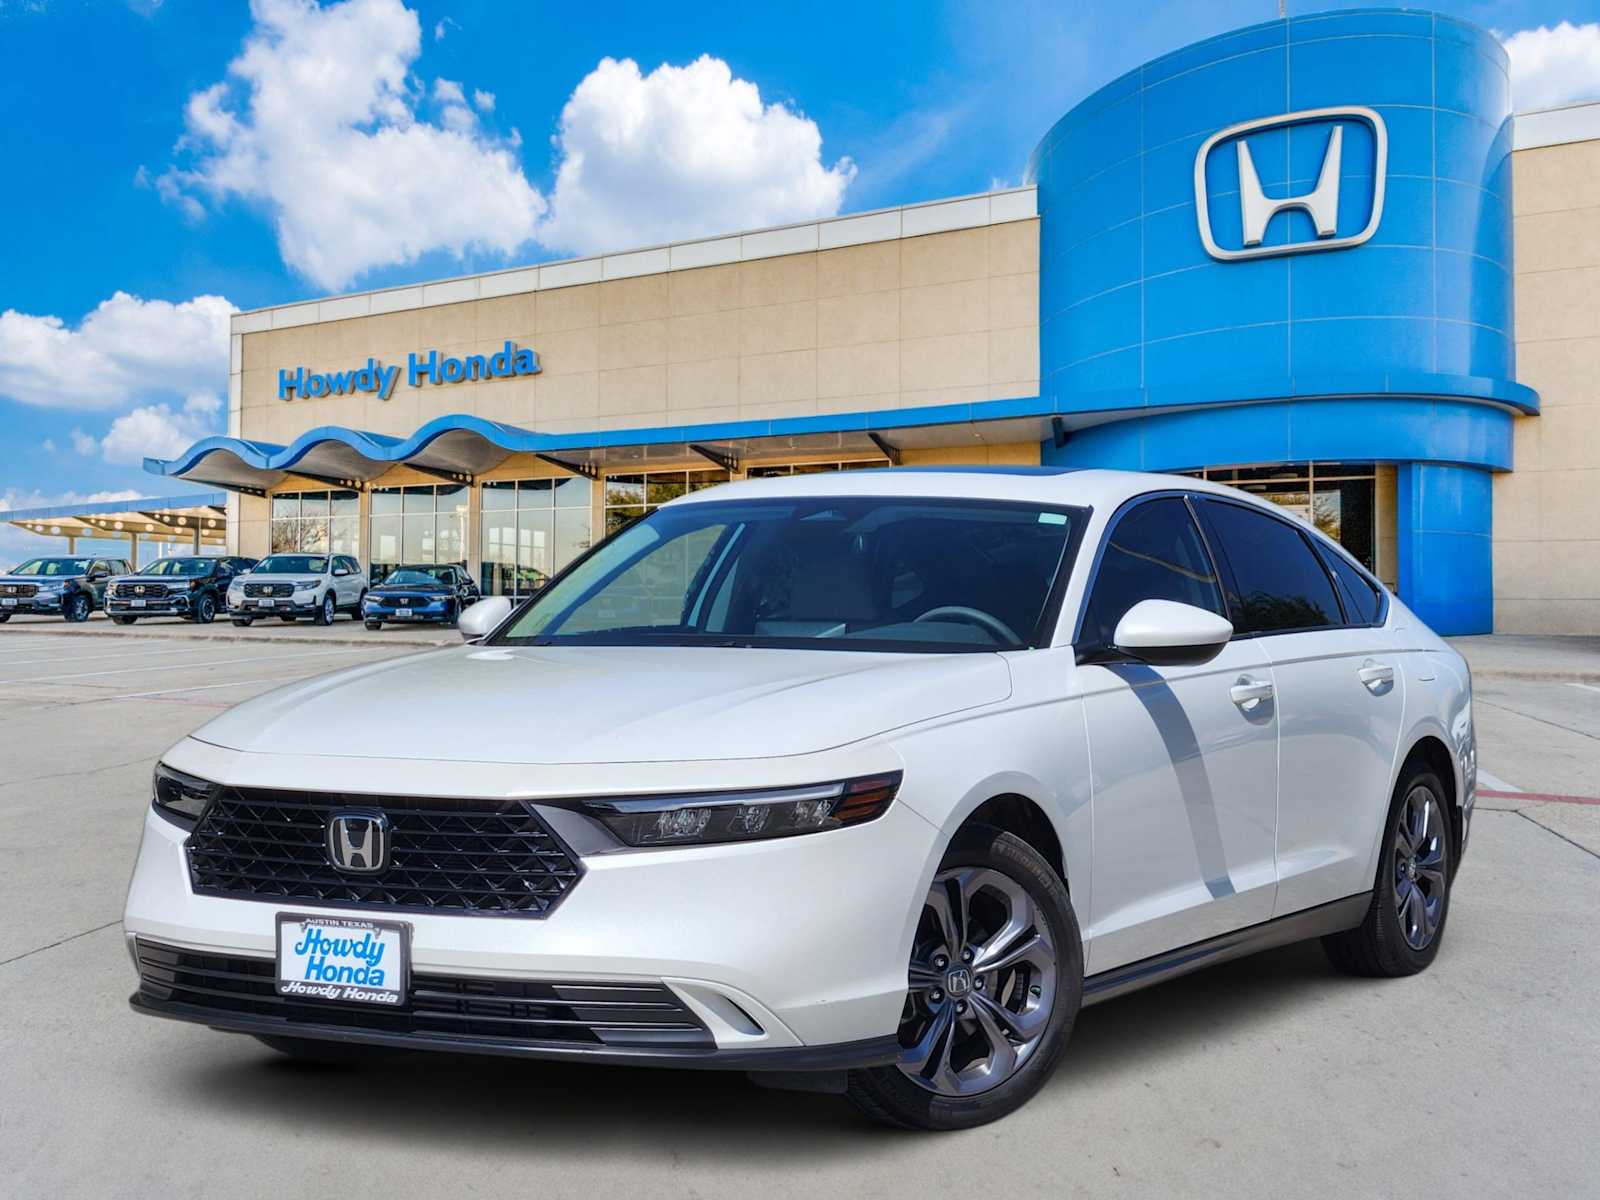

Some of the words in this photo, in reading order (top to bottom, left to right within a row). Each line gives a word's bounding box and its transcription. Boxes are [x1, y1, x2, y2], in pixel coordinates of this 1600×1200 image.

[278, 358, 401, 400] Howdy
[408, 341, 542, 387] Honda
[305, 918, 341, 927] AUSTIN
[342, 920, 374, 929] TEXAS
[295, 928, 385, 966] Howdy
[304, 956, 385, 986] Honda
[281, 982, 341, 999] Howdy
[343, 986, 398, 1003] Honda
